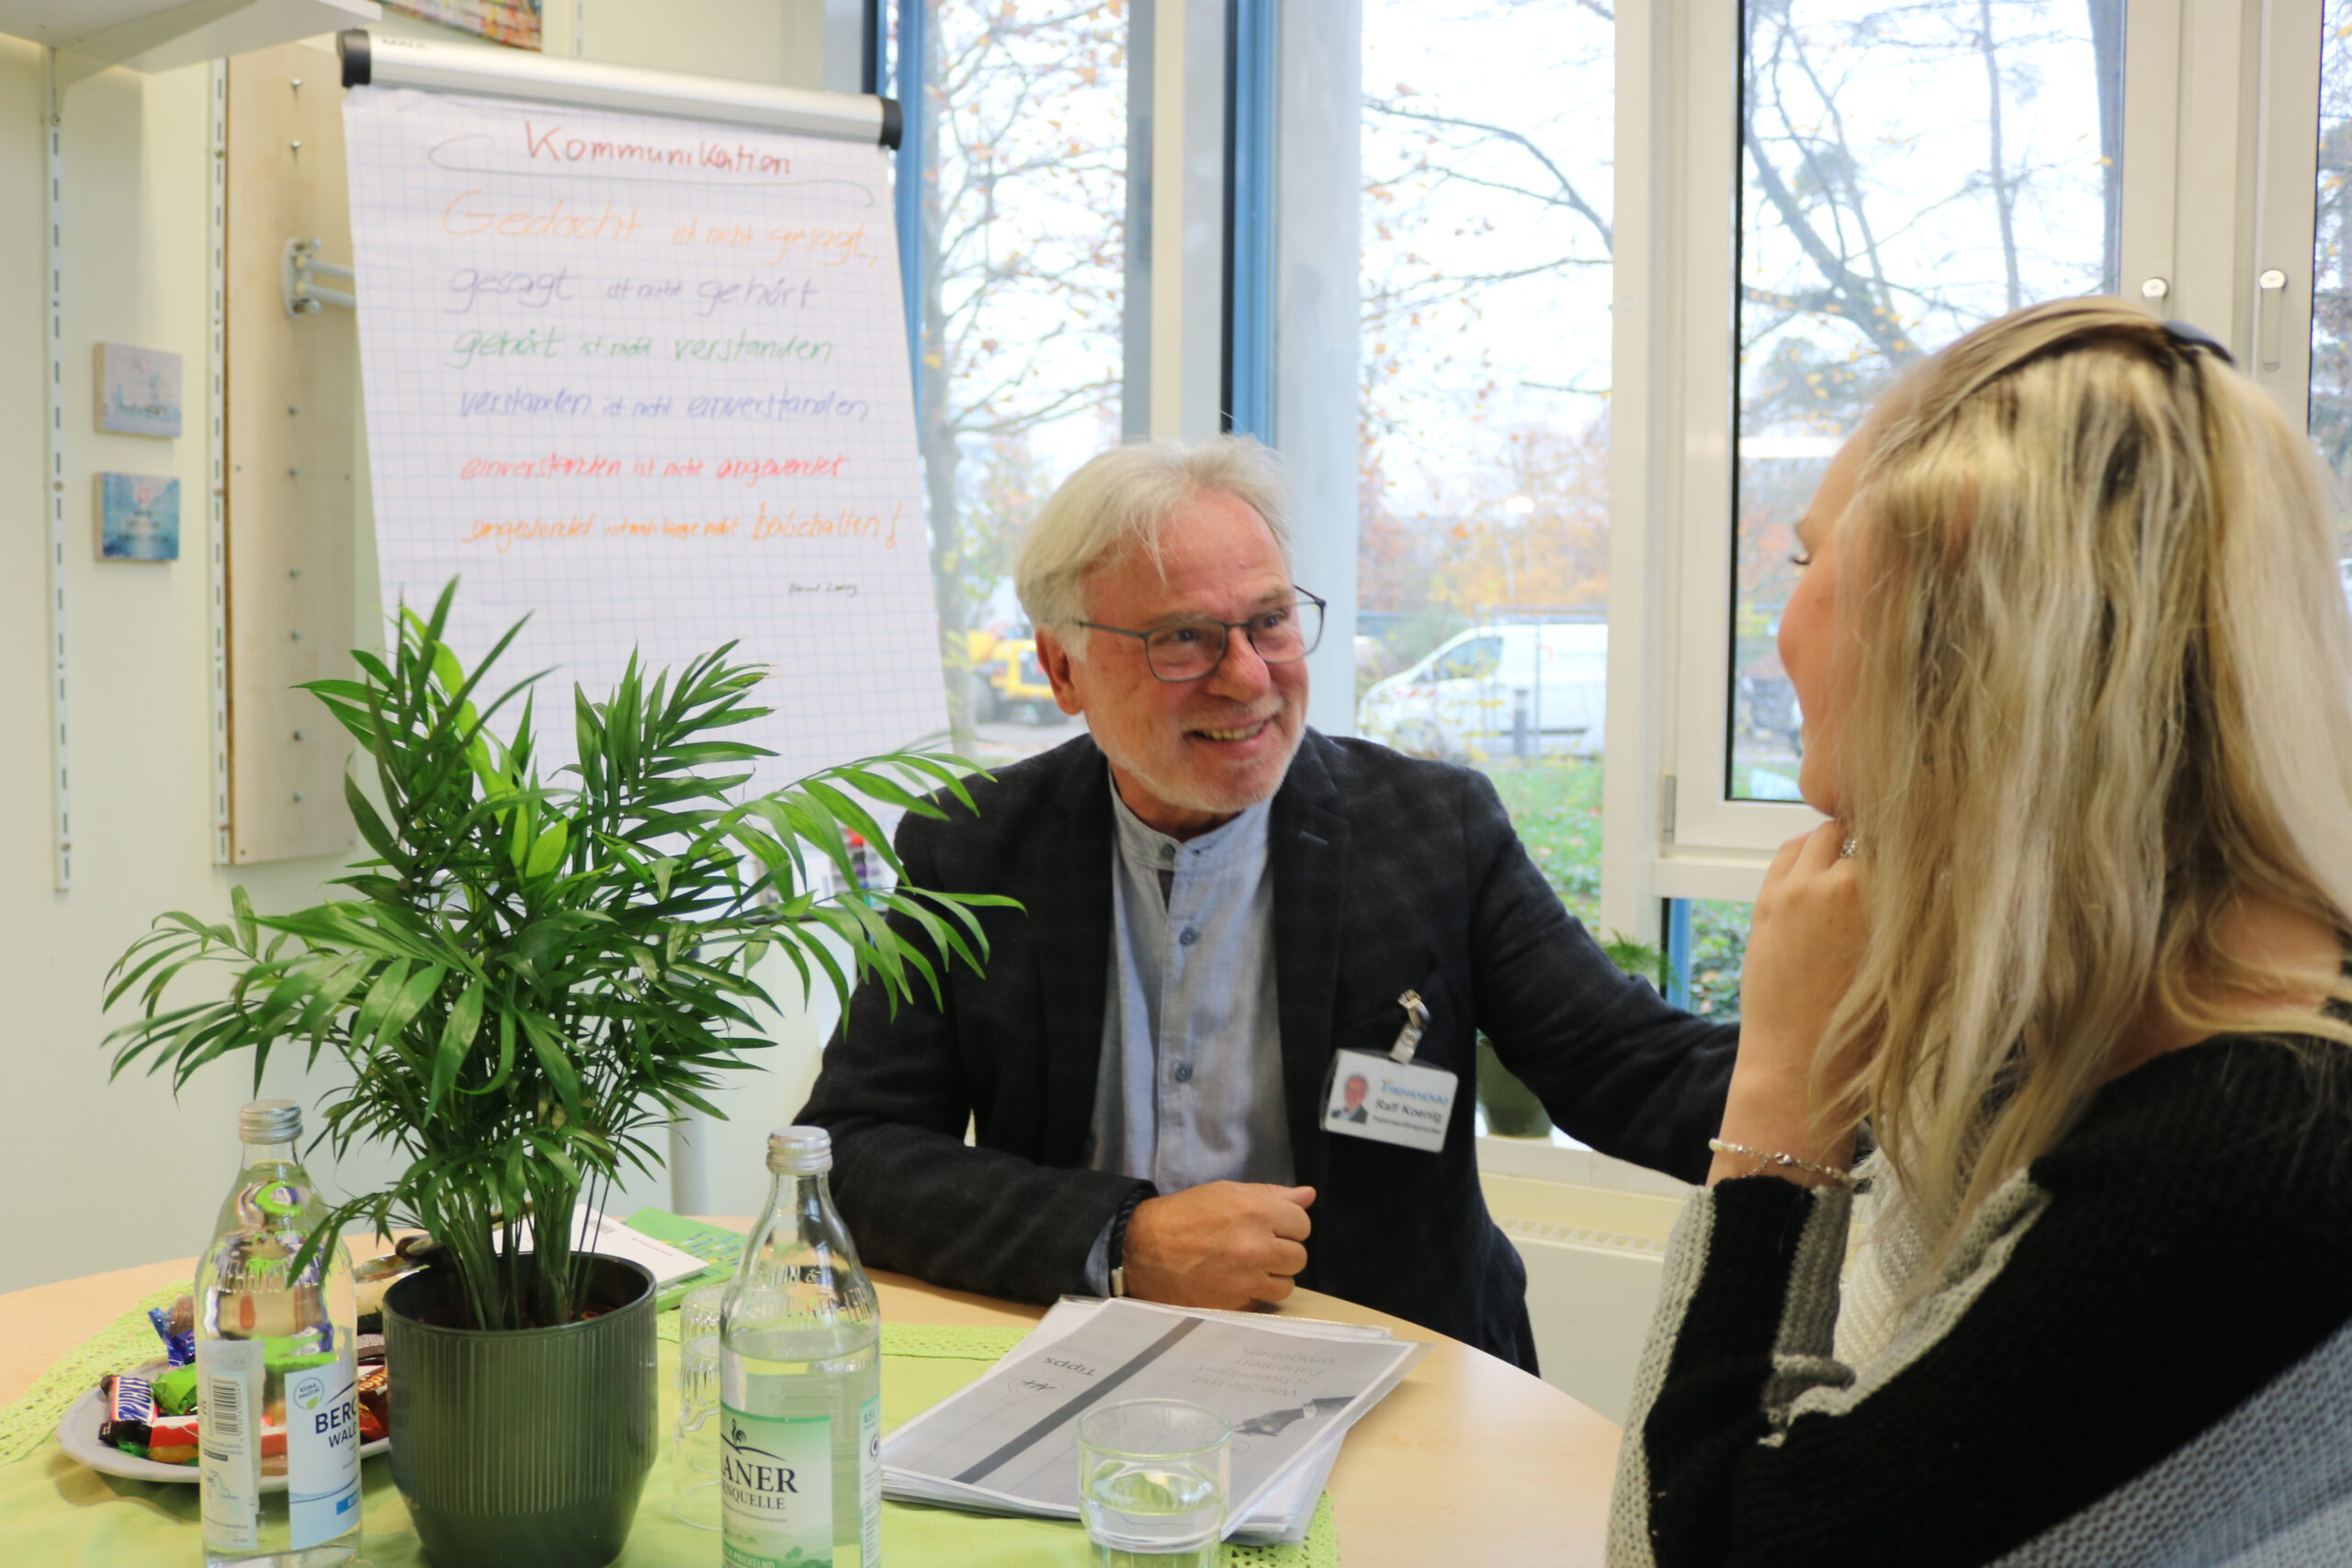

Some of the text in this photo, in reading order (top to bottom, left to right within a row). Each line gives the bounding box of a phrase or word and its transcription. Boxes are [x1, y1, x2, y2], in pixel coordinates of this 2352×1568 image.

[525, 120, 792, 175] Kommunikation
[442, 189, 645, 241] Gedacht
[442, 265, 582, 314] gesagt
[695, 275, 820, 318] gehört
[675, 328, 832, 363] verstanden
[460, 386, 591, 418] verstanden
[688, 383, 869, 421] einverstanden
[459, 452, 623, 480] einverstanden
[716, 452, 852, 488] angewendet
[1043, 1357, 1097, 1377] Tipps
[722, 1454, 799, 1494] ANER
